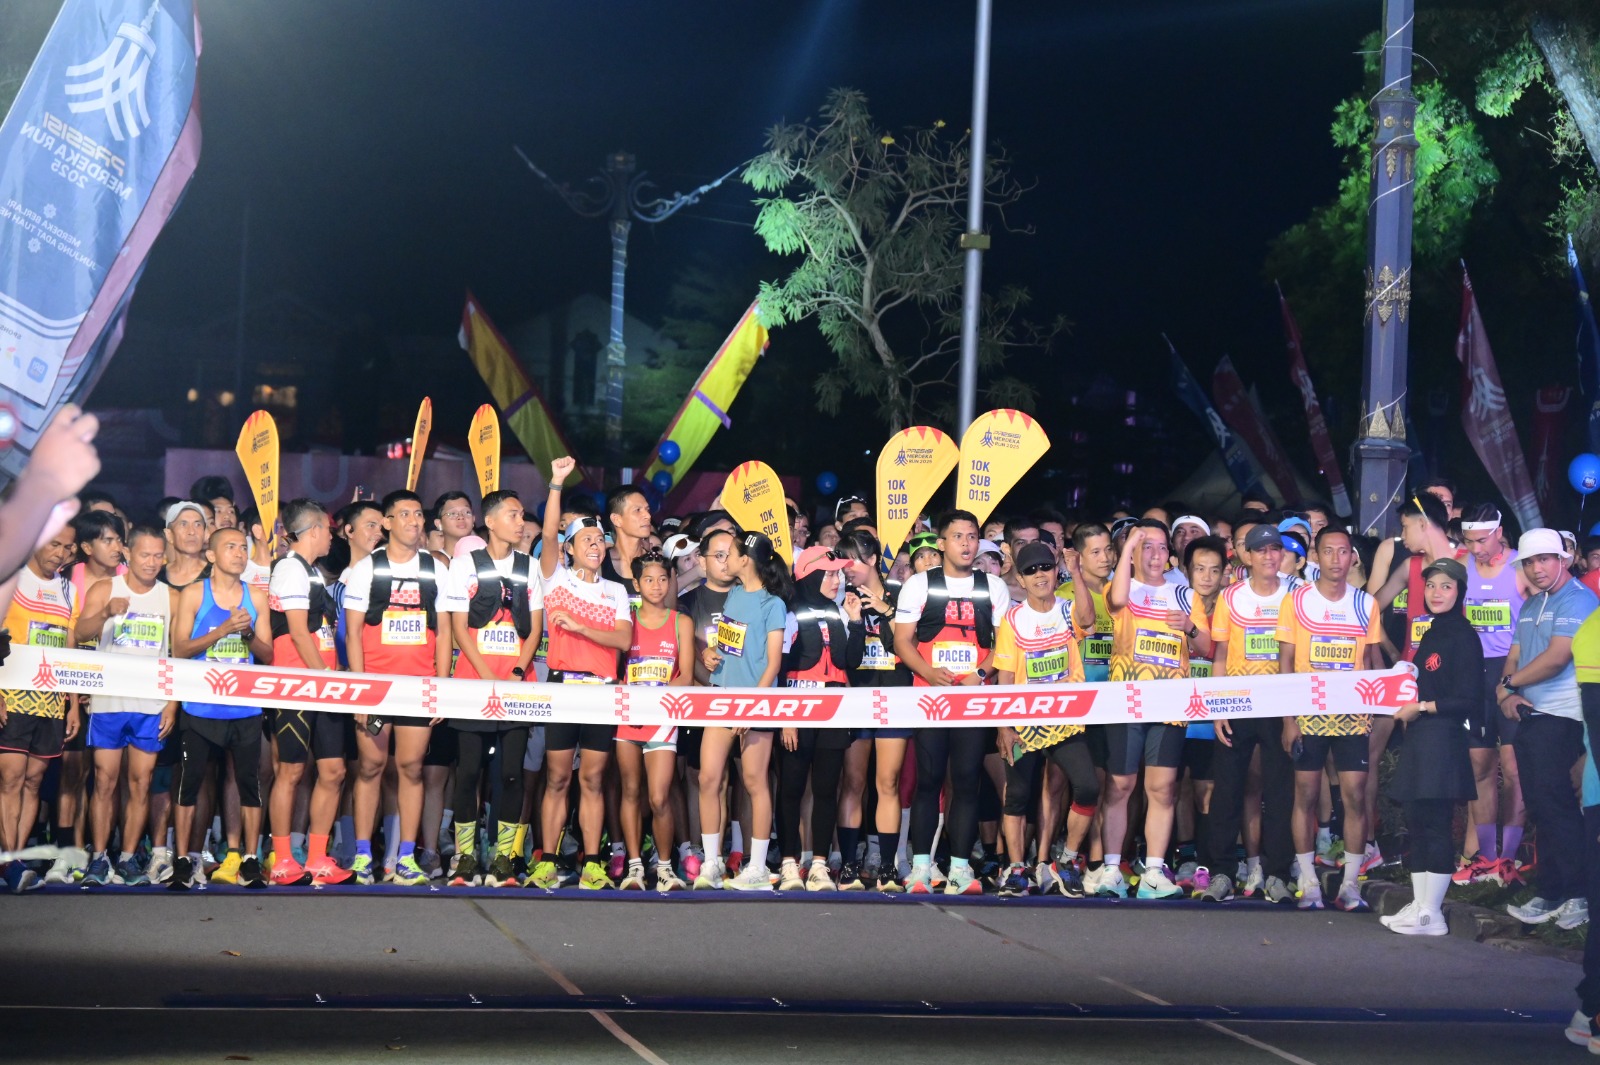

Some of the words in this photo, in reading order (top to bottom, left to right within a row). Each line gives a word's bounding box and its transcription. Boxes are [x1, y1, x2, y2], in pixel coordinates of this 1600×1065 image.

[260, 462, 269, 474] 10K
[971, 459, 990, 472] 10K
[485, 468, 493, 482] SUB
[969, 474, 991, 487] SUB
[261, 475, 271, 490] SUB
[888, 479, 906, 490] 10K
[261, 489, 274, 506] 01.00
[888, 493, 908, 505] SUB
[969, 489, 991, 502] 01.15
[760, 508, 774, 523] 10K
[888, 508, 909, 520] 01.15
[763, 522, 778, 536] SUB
[1471, 609, 1503, 621] 8011110
[389, 620, 421, 632] PACER
[483, 630, 515, 643] PACER
[1139, 639, 1178, 655] 8010006
[1314, 645, 1353, 659] 8010397
[938, 649, 971, 662] PACER
[1031, 656, 1065, 673] 8011017
[55, 669, 104, 680] MERDEKA
[632, 666, 668, 678] 8010419
[59, 678, 78, 686] RUN
[80, 679, 104, 688] 2025
[250, 676, 371, 701] START
[504, 701, 552, 709] MERDEKA
[706, 698, 823, 717] START
[963, 695, 1078, 716] START
[1205, 697, 1252, 706] MERDEKA
